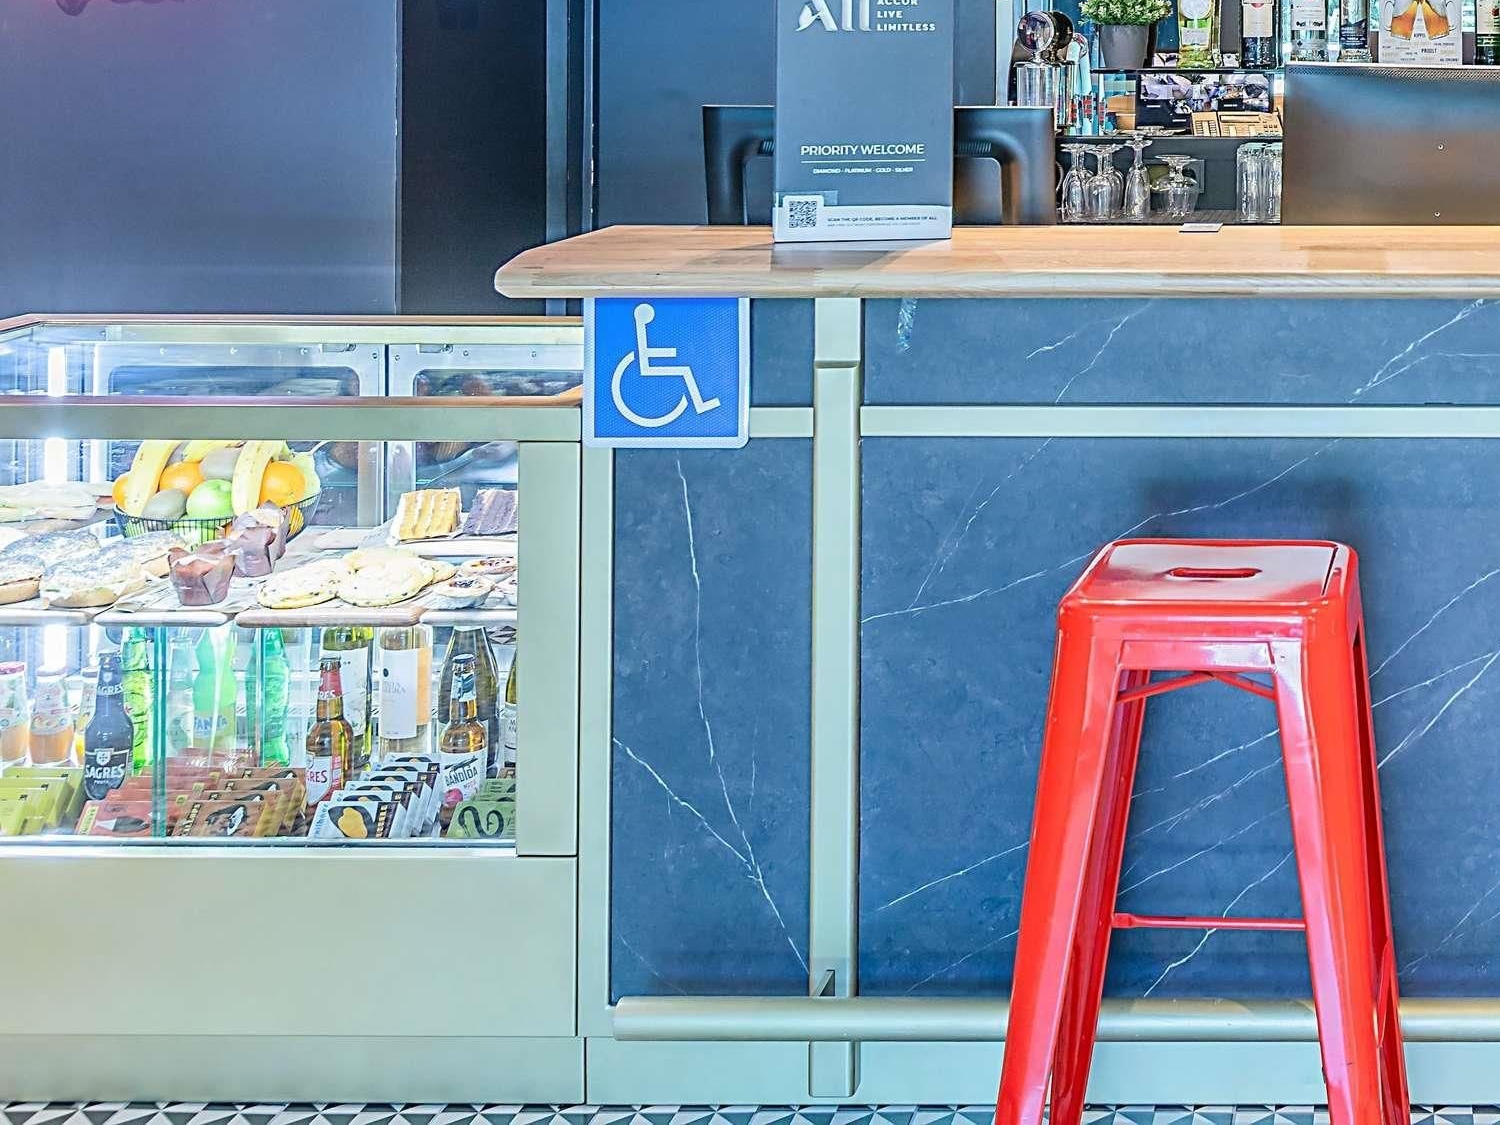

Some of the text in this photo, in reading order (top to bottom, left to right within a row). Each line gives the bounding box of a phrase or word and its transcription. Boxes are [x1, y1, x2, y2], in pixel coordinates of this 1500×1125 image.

[877, 10, 903, 18] LIVE
[877, 23, 936, 31] LIMITLESS
[801, 144, 925, 155] PRIORITY WELCOME
[85, 763, 126, 779] SAGRES
